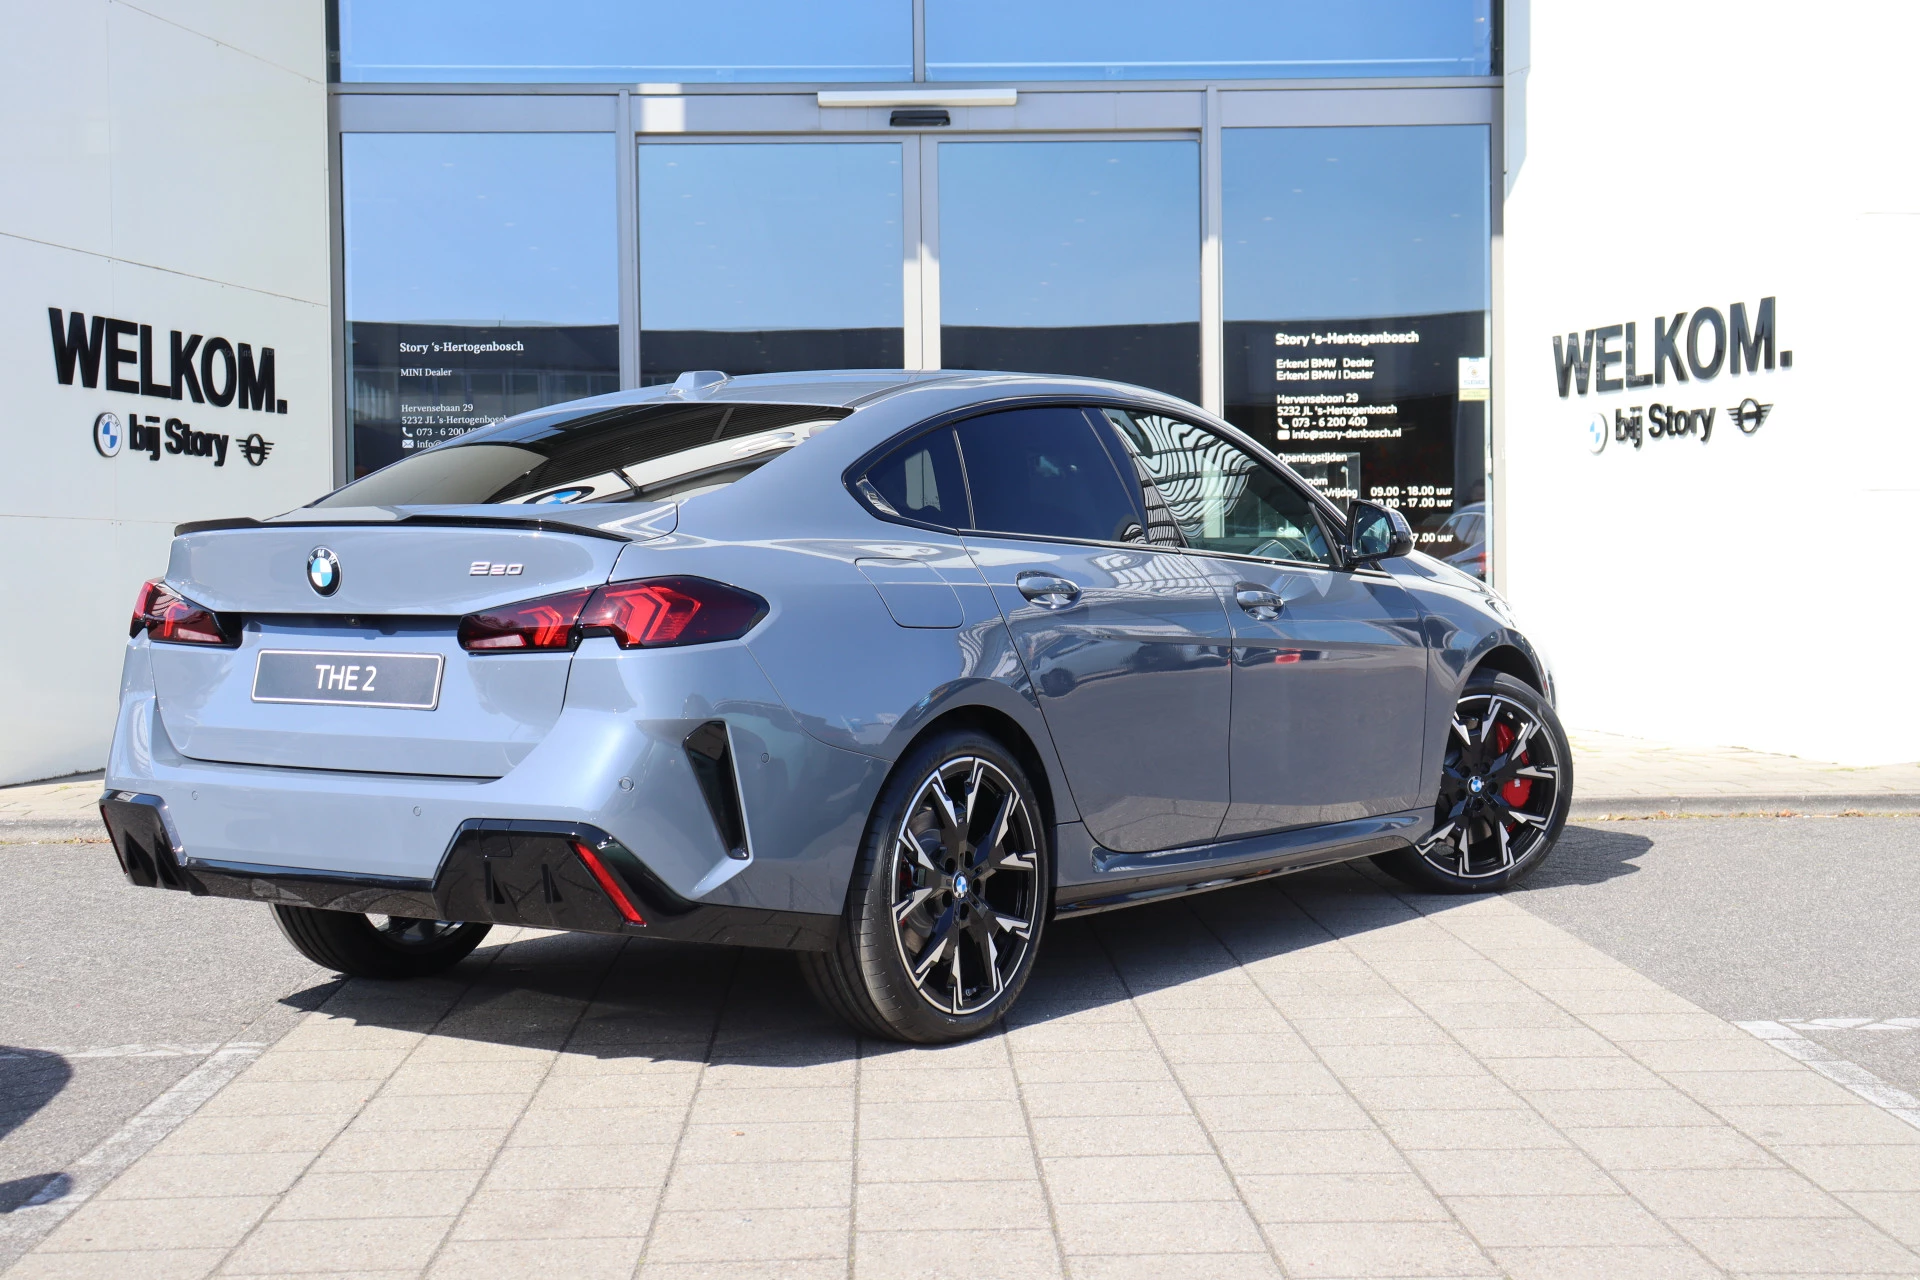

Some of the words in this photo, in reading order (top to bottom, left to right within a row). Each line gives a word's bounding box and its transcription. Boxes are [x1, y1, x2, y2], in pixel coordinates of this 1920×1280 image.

[1275, 332, 1310, 347] Story
[400, 342, 429, 355] Story
[1552, 296, 1793, 399] WELKOM.
[48, 306, 288, 414] WELKOM.
[1276, 358, 1309, 369] Erkend
[1311, 358, 1336, 369] BMW
[1342, 357, 1374, 368] Dealer
[400, 368, 423, 377] MINI
[424, 367, 452, 377] Dealer
[1276, 370, 1309, 381] Erkend
[1311, 370, 1336, 380] BMW
[1342, 369, 1374, 380] Dealer
[1277, 394, 1344, 404] Hervensebaan
[1345, 393, 1359, 403] 29
[401, 404, 460, 412] Hervensebaan
[462, 403, 473, 412] 29
[1277, 406, 1300, 416] 5232
[1302, 406, 1313, 416] JL
[401, 416, 423, 425] 5232
[424, 416, 435, 424] JL
[1291, 417, 1310, 427] 073
[1318, 417, 1325, 427] 6
[1327, 417, 1346, 427] 200
[1347, 416, 1368, 426] 400
[1615, 405, 1643, 450] bij
[1648, 402, 1717, 442] Story
[416, 428, 433, 436] 073
[440, 428, 446, 436] 6
[448, 427, 464, 436] 200
[1291, 428, 1401, 440] info@story-denbosch.nl
[129, 413, 161, 461] bij
[164, 418, 230, 467] Story
[1277, 452, 1348, 464] Openingstijden
[1370, 486, 1399, 496] 09.00
[1407, 486, 1434, 496] 18.00
[1436, 487, 1453, 495] uur
[1436, 499, 1453, 507] uur
[1437, 534, 1454, 542] uur
[469, 561, 524, 576] 220
[315, 664, 360, 691] THE
[362, 666, 377, 691] 2
